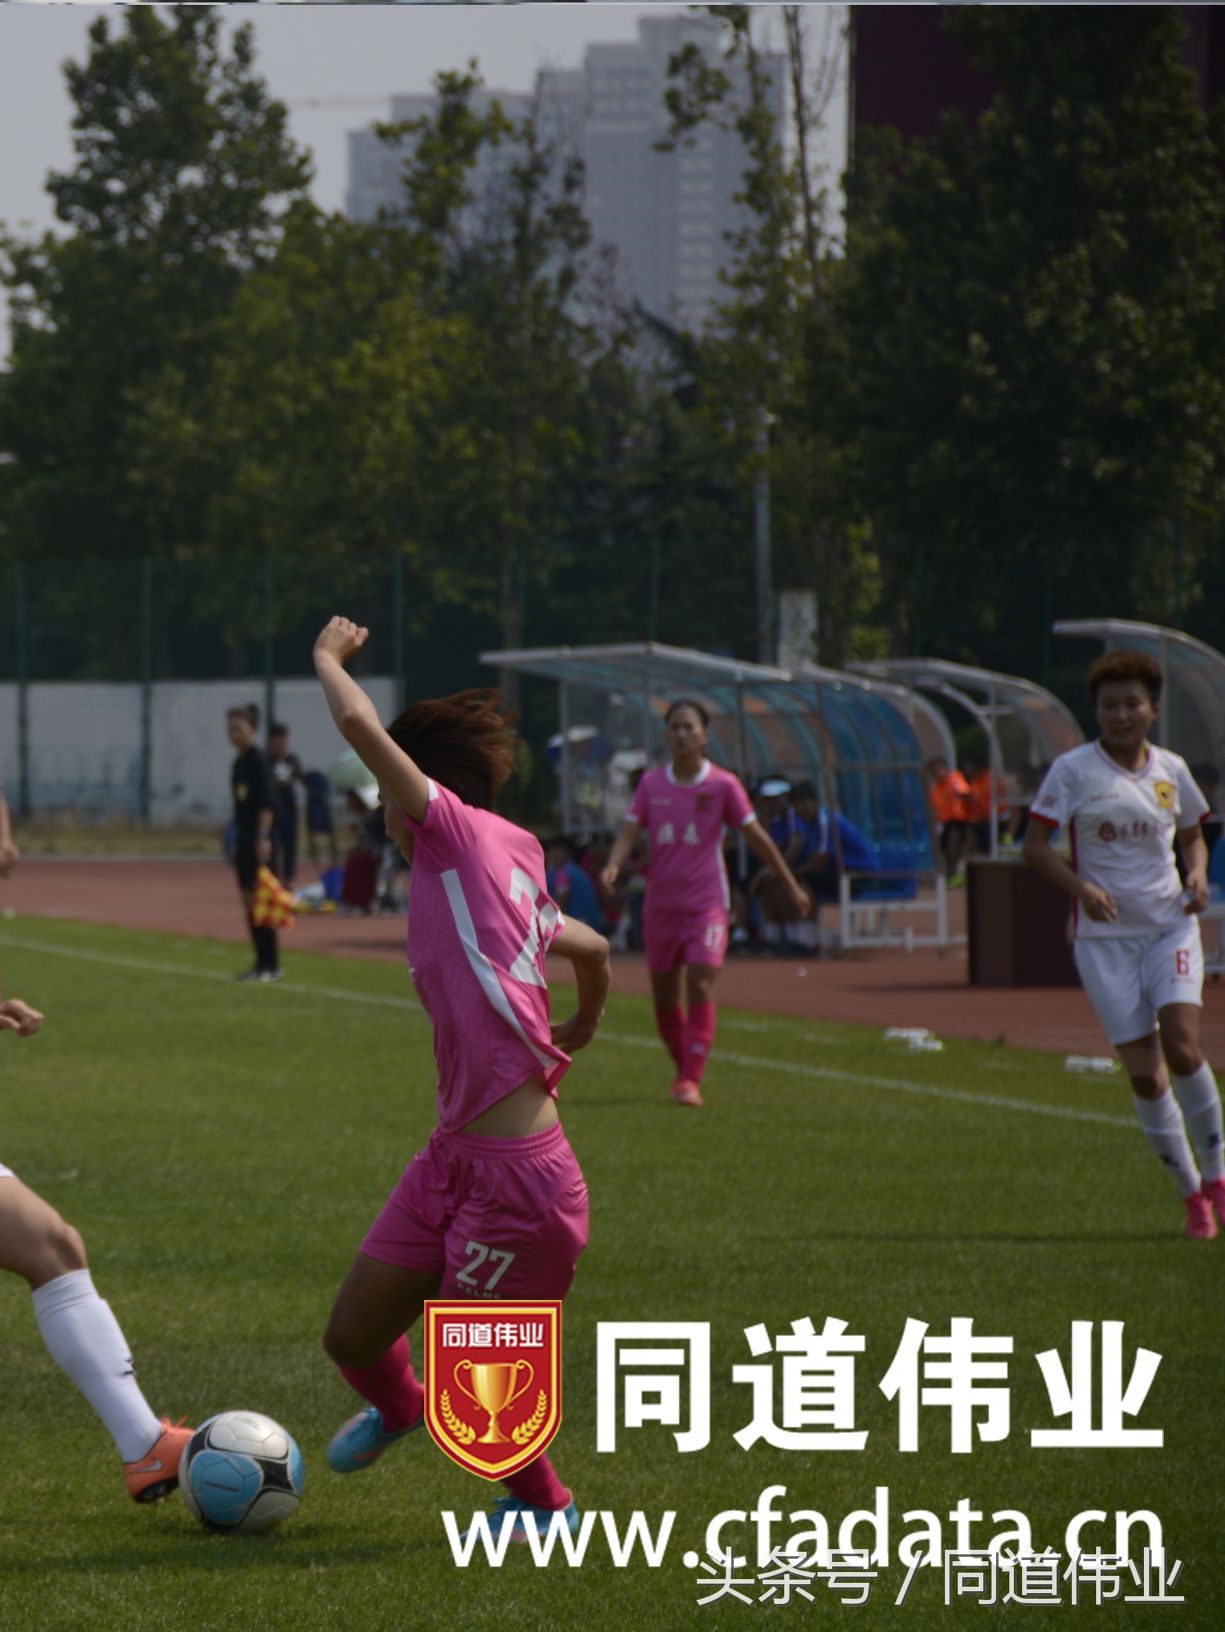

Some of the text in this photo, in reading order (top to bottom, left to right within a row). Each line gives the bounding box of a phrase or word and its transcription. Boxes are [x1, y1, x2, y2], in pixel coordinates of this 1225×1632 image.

[1176, 950, 1190, 977] 6
[456, 1240, 516, 1291] 27
[457, 1282, 503, 1300] KELME
